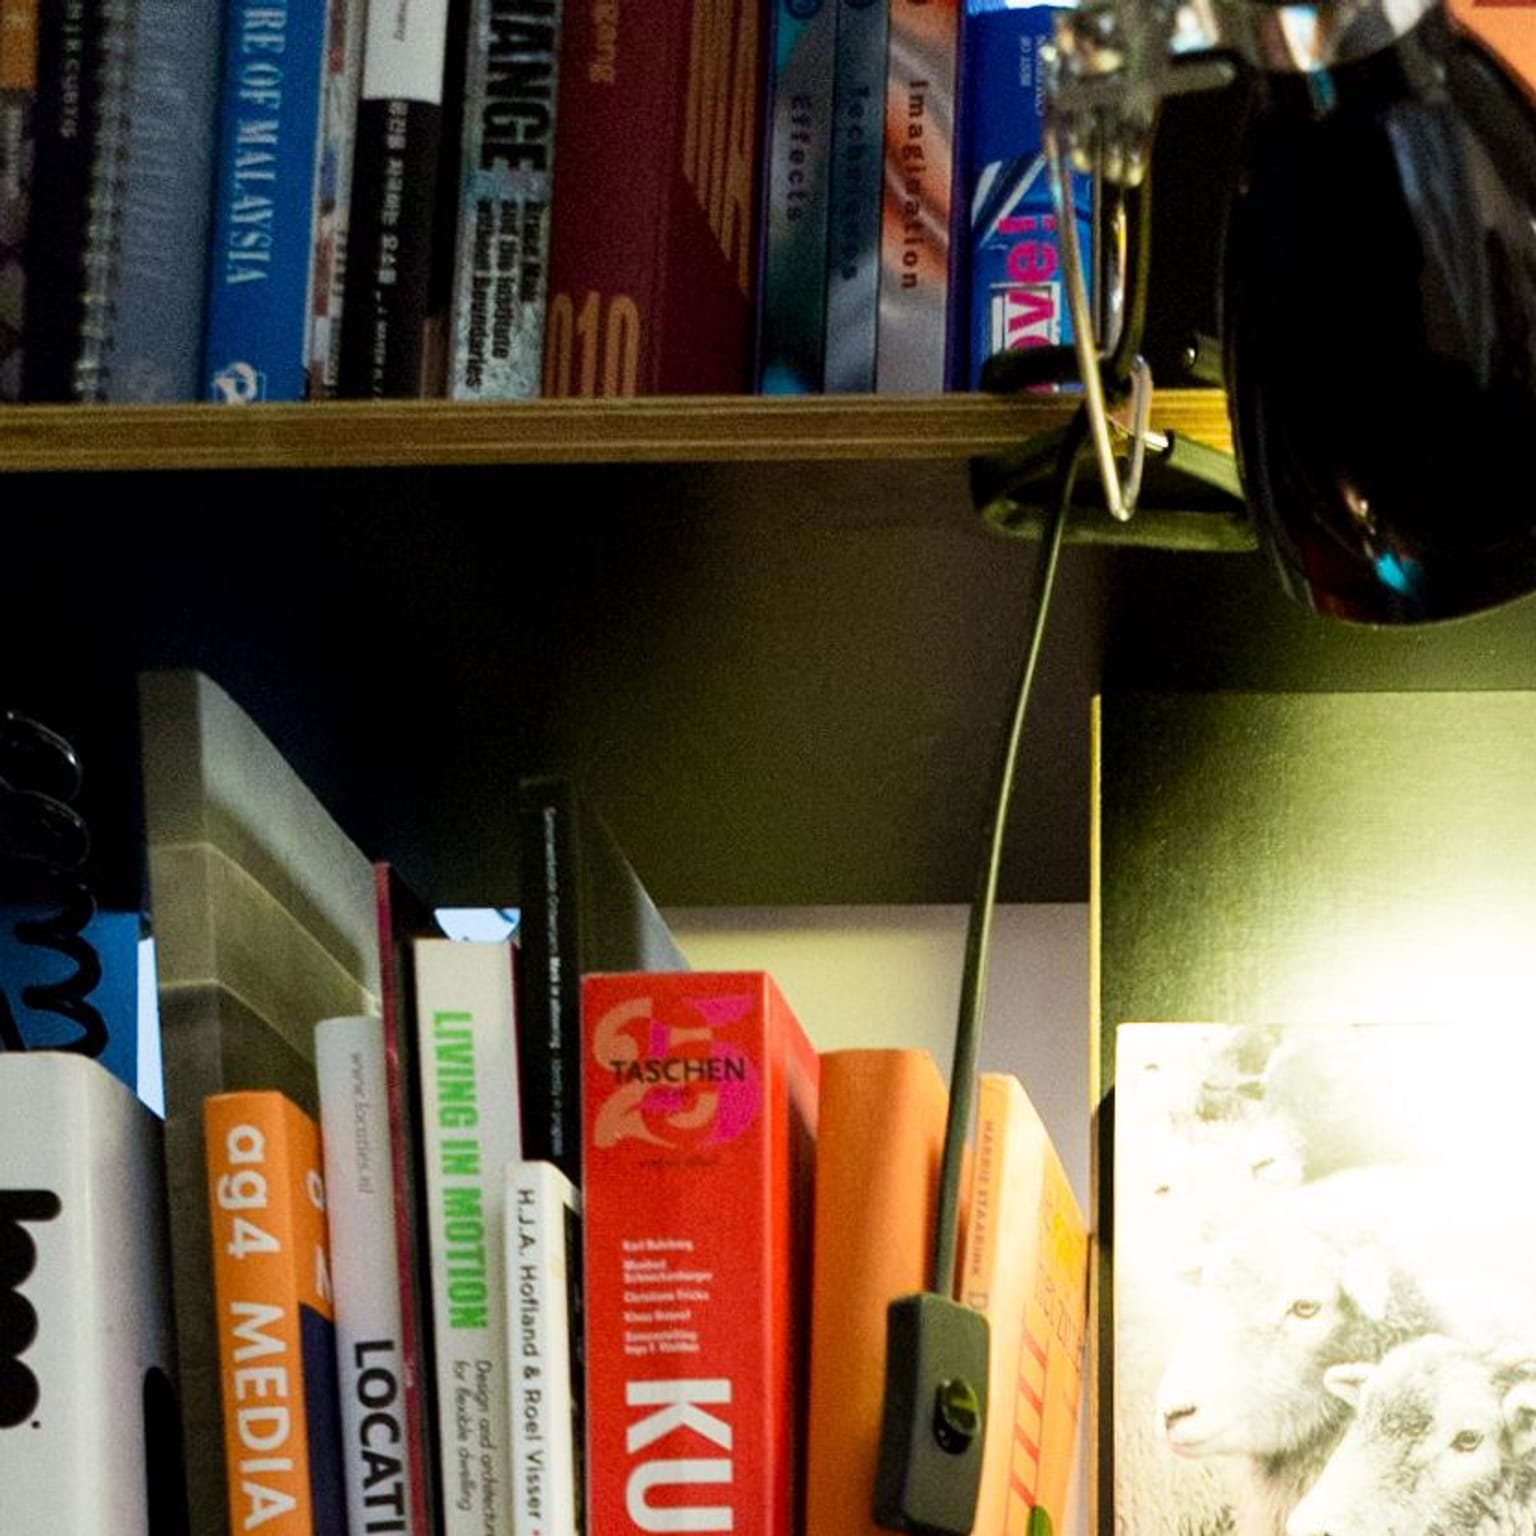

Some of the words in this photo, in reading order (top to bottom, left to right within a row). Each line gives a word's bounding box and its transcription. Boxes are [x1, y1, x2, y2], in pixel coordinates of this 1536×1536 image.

[241, 0, 287, 54] RE
[240, 62, 283, 109] OF
[786, 94, 808, 223] Effects
[901, 79, 928, 290] Imagination
[226, 117, 279, 285] MALAYSIA
[464, 274, 494, 390] Boundaries
[432, 1011, 480, 1129] LIVING
[609, 1057, 747, 1084] TASCHEN
[216, 1123, 281, 1260] ag4
[440, 1139, 482, 1177] IN
[516, 1189, 537, 1257] H.J.A.
[442, 1187, 489, 1330] MOTION
[520, 1263, 542, 1358] Hofland
[451, 1359, 470, 1381] for
[474, 1359, 493, 1413] Design
[523, 1364, 541, 1381] &
[226, 1302, 298, 1532] MEDIA
[454, 1386, 473, 1442] flexible
[479, 1417, 496, 1449] and
[524, 1388, 543, 1441] Roel
[456, 1446, 476, 1512] dwelling
[526, 1449, 544, 1521] Visser
